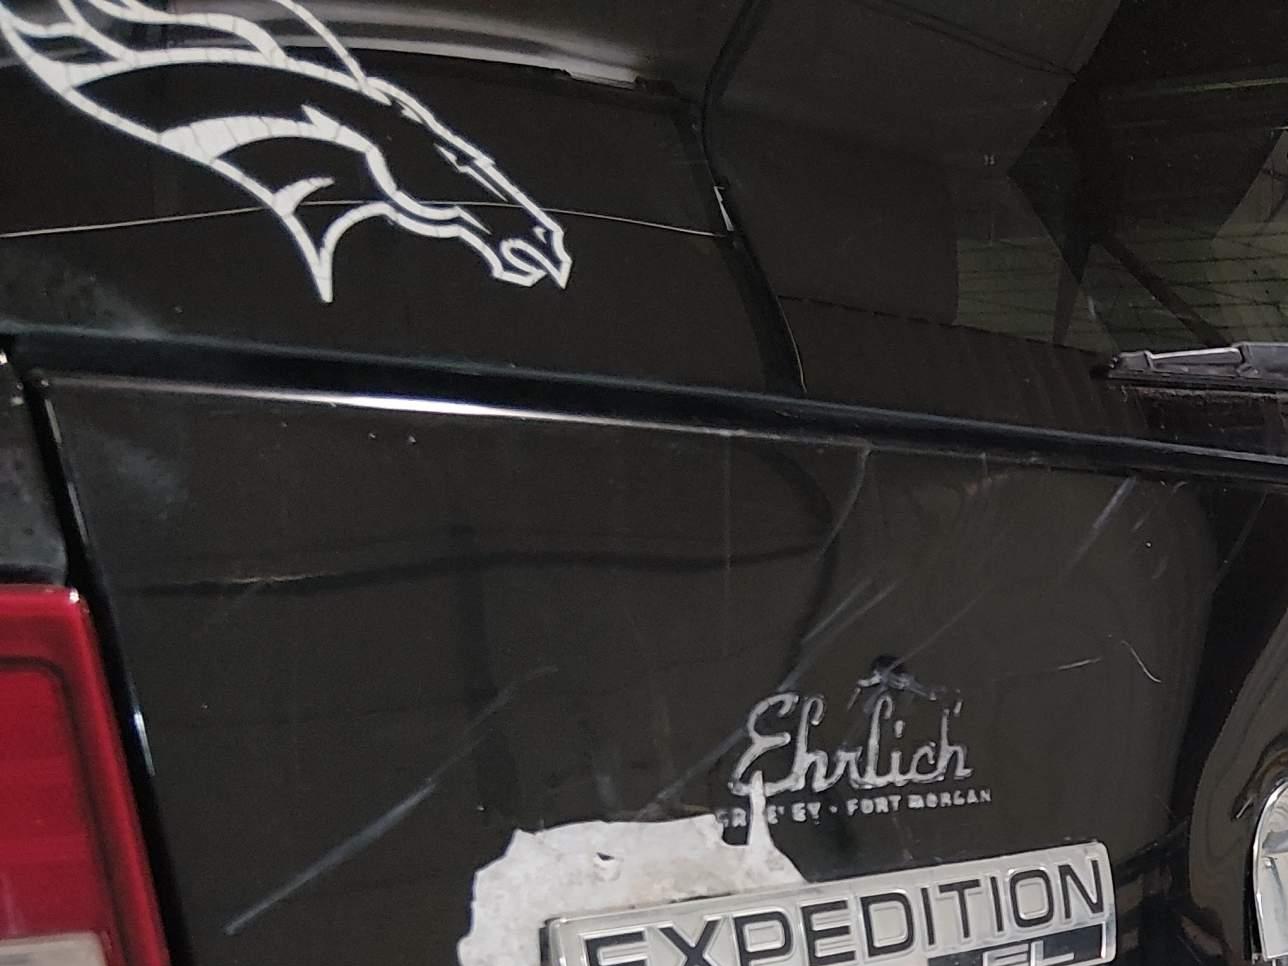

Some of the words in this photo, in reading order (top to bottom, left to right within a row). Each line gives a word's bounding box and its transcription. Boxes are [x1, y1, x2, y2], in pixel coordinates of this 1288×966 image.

[727, 691, 973, 797] Ehrlich
[846, 795, 902, 816] FORT
[907, 788, 992, 809] MORGAN
